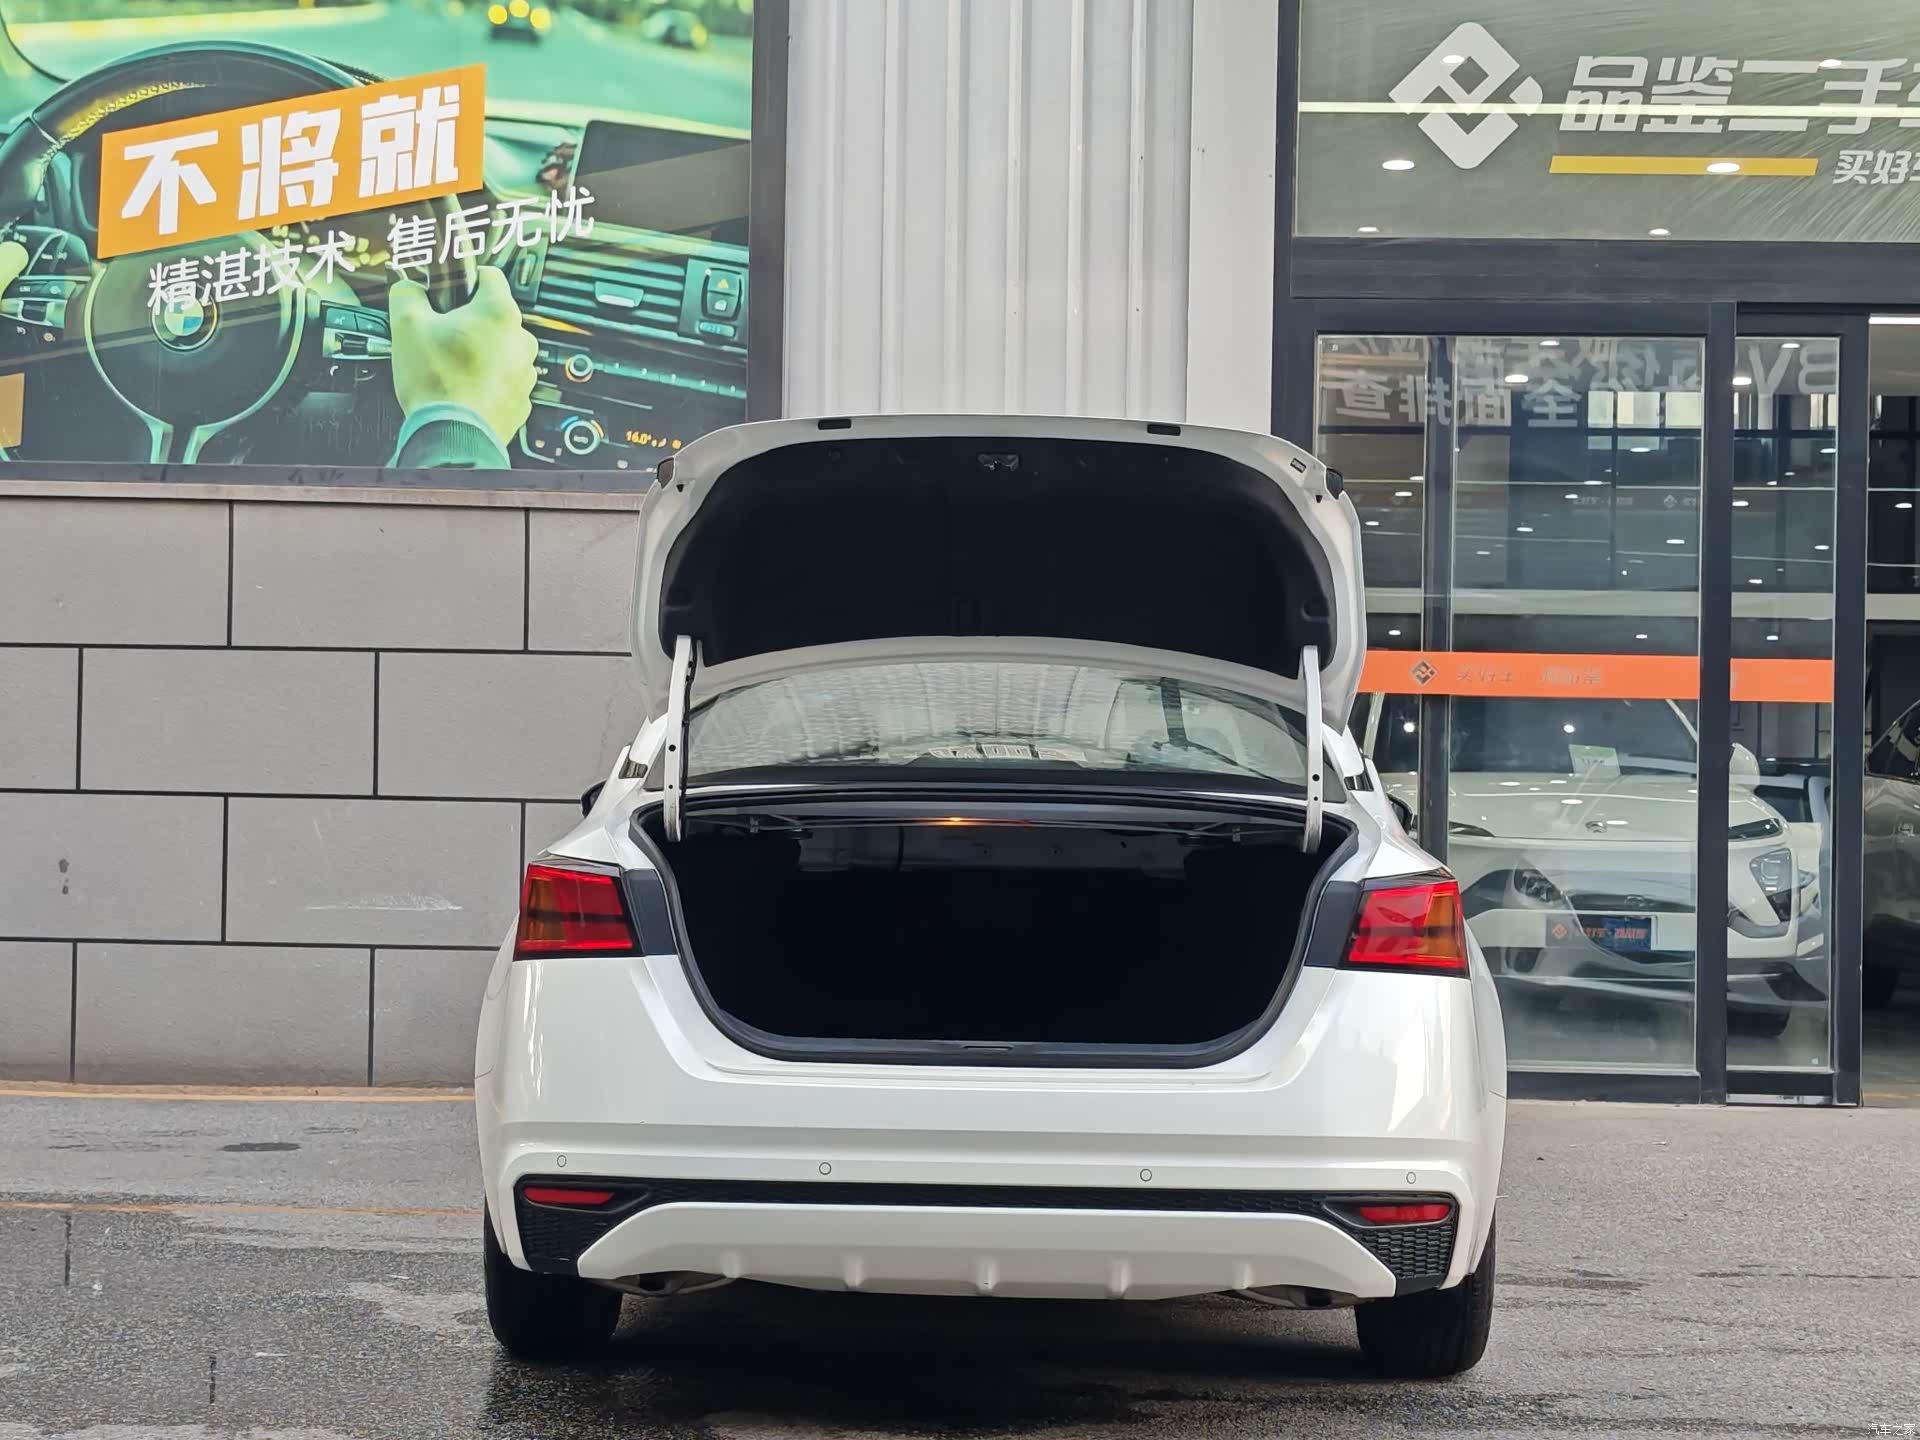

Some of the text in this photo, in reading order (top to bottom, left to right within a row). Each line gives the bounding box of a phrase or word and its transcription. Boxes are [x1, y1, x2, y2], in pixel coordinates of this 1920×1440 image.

[121, 84, 462, 236] 不将就
[1559, 55, 1920, 134] 品鉴二手
[147, 185, 596, 316] 精湛技术 售后无忧
